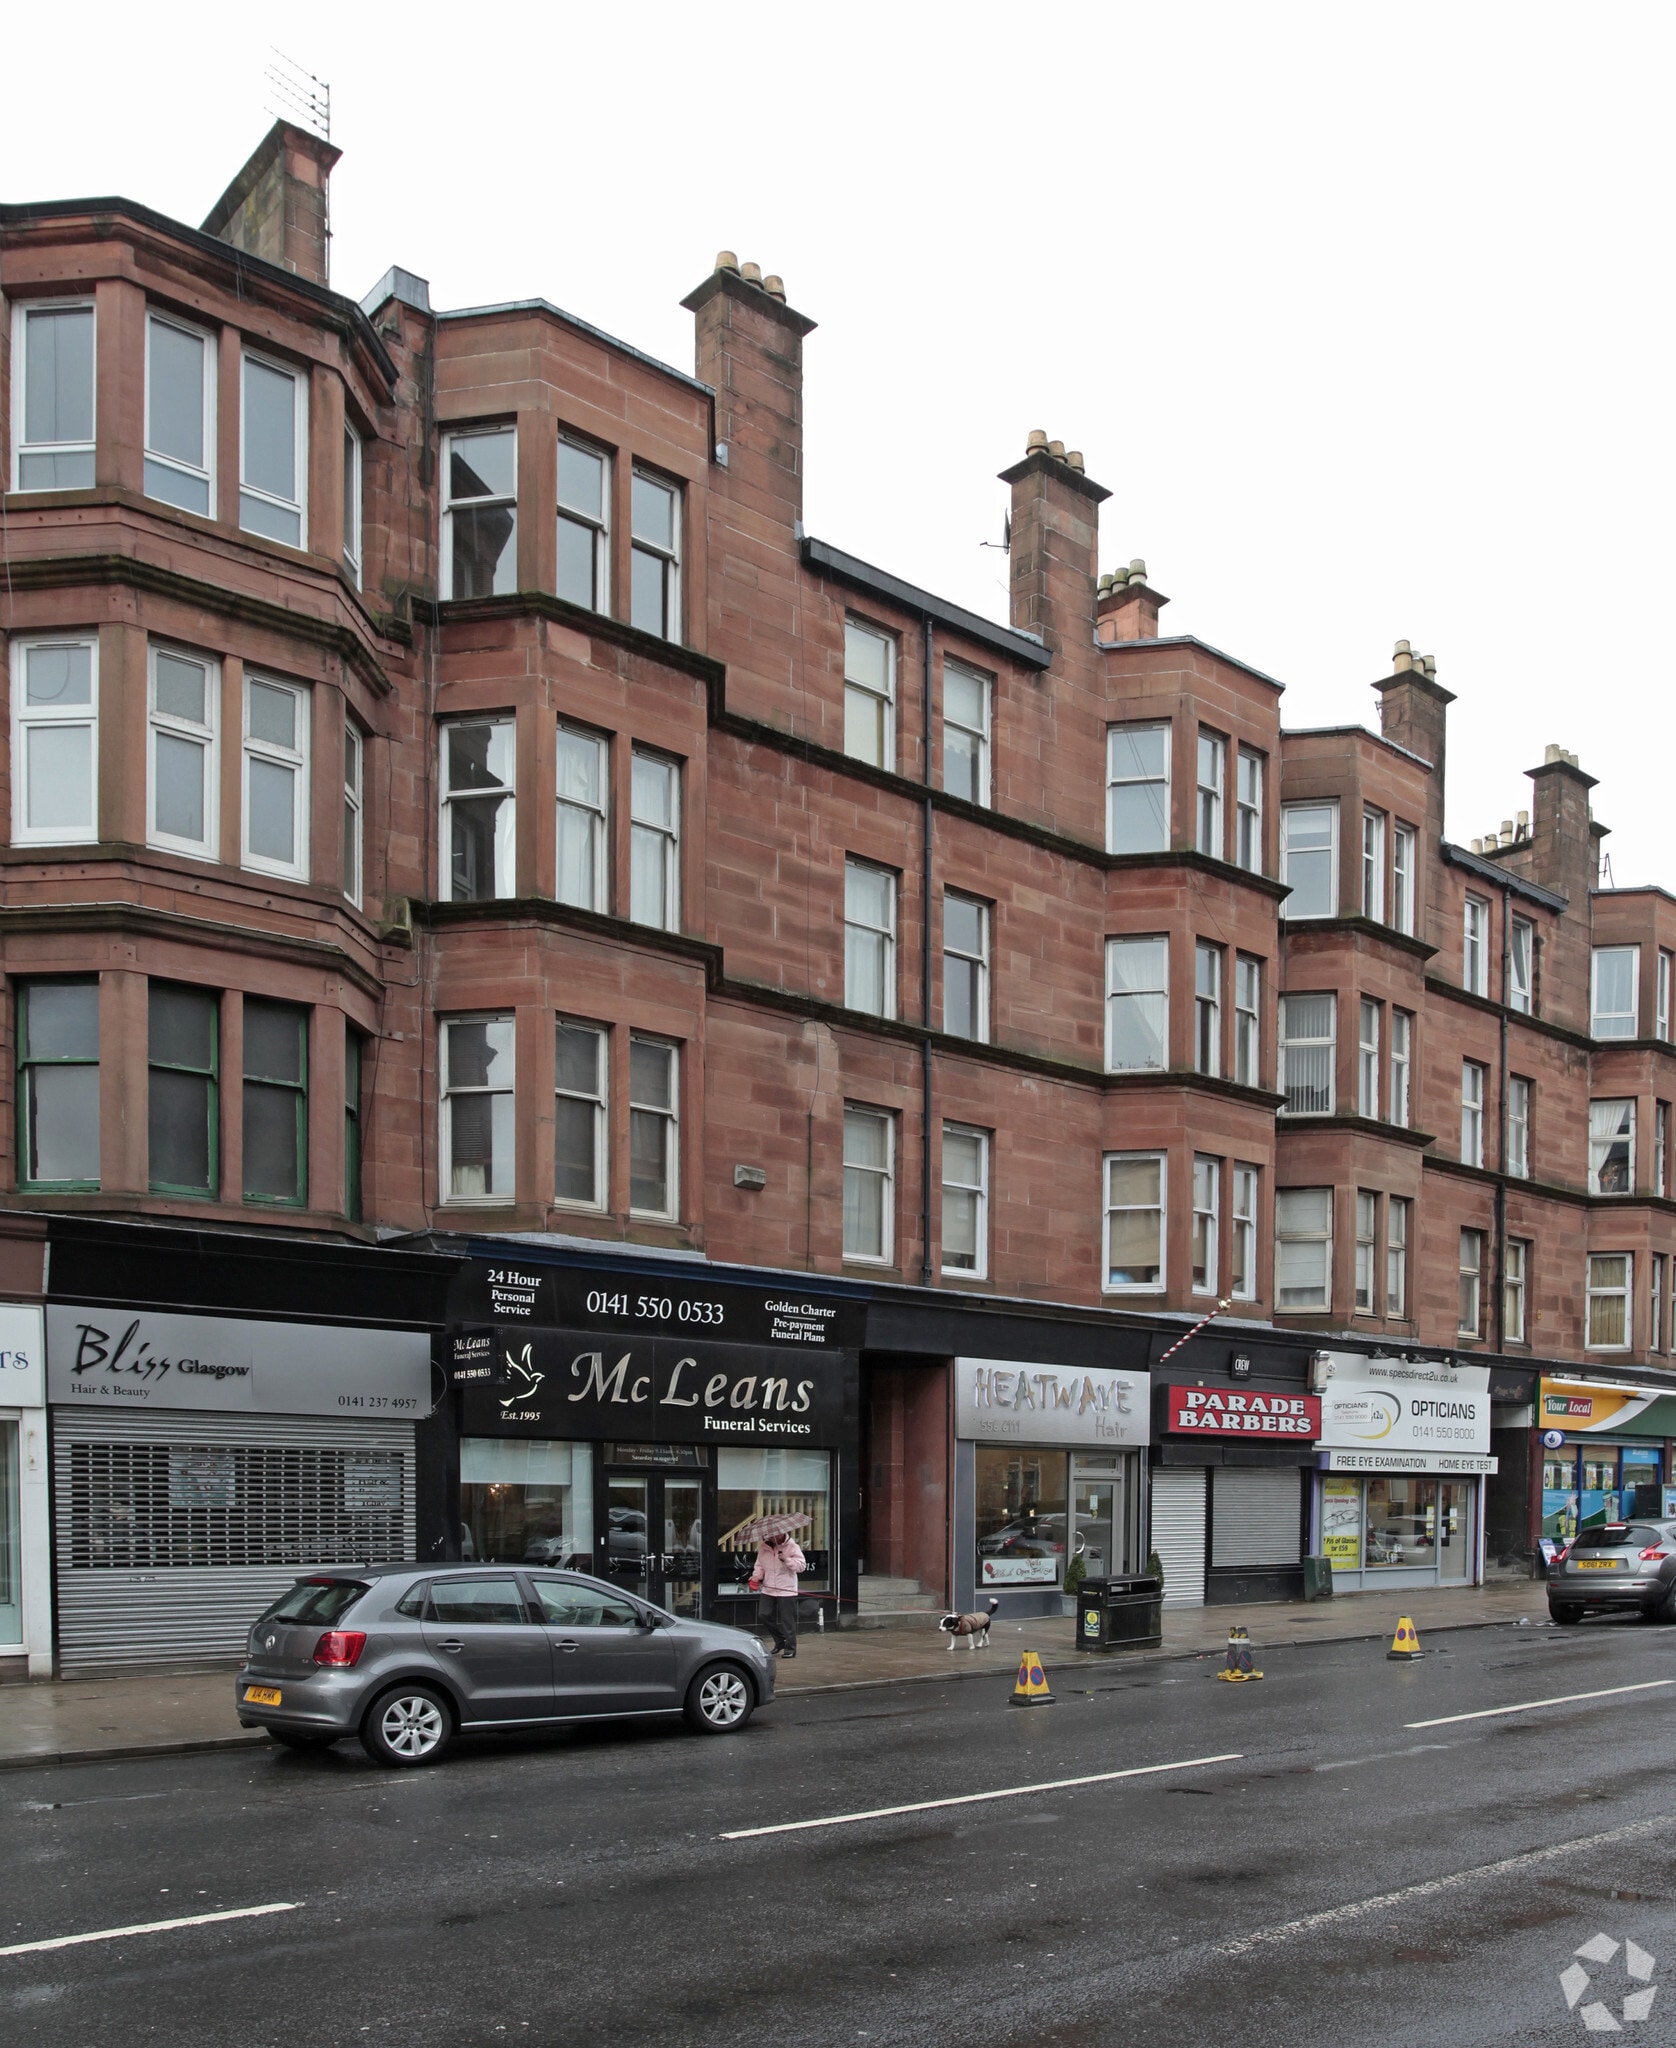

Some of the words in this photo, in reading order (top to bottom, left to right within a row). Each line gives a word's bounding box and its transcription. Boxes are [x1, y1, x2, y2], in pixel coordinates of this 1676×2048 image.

[487, 1269, 505, 1283] 24
[507, 1271, 542, 1287] Hour
[491, 1289, 535, 1304] Personal
[494, 1302, 531, 1316] Service
[586, 1290, 629, 1316] 0141
[634, 1296, 672, 1320] 550
[677, 1300, 724, 1325] 0533
[765, 1300, 799, 1314] Golden
[801, 1304, 836, 1318] Charter
[773, 1317, 825, 1332] Pre-payment
[771, 1328, 802, 1340] Funeral
[804, 1331, 826, 1343] Plans
[70, 1318, 171, 1382] Bliss
[177, 1359, 250, 1380] Glasgow
[1234, 1358, 1250, 1371] CREW
[1368, 1366, 1459, 1384] www.specsdirect2u.co.uk
[71, 1383, 97, 1395] Hair
[100, 1385, 110, 1395] &
[113, 1385, 151, 1400] Beauty
[974, 1367, 1136, 1416] HEATWAVE
[338, 1395, 365, 1408] 0141
[369, 1397, 388, 1408] 237
[391, 1398, 418, 1410] 4957
[1186, 1391, 1305, 1416] PARADE
[1333, 1402, 1369, 1410] OPTICIANS
[1411, 1399, 1476, 1420] OPTICIANS
[1547, 1400, 1566, 1412] Your
[1568, 1401, 1591, 1414] Local
[704, 1415, 755, 1432] Funeral
[758, 1417, 811, 1434] Services
[1094, 1416, 1128, 1438] Hair
[1178, 1410, 1312, 1434] BARBERS
[1413, 1425, 1434, 1438] 0141
[1436, 1427, 1453, 1439] 550
[1454, 1428, 1475, 1440] 8000
[1336, 1456, 1357, 1467] FREE
[1359, 1456, 1373, 1467] EYE
[1375, 1457, 1427, 1468] EXAMINATION
[1438, 1459, 1460, 1469] HOME
[1461, 1460, 1475, 1470] EYE
[1476, 1460, 1492, 1470] TEST
